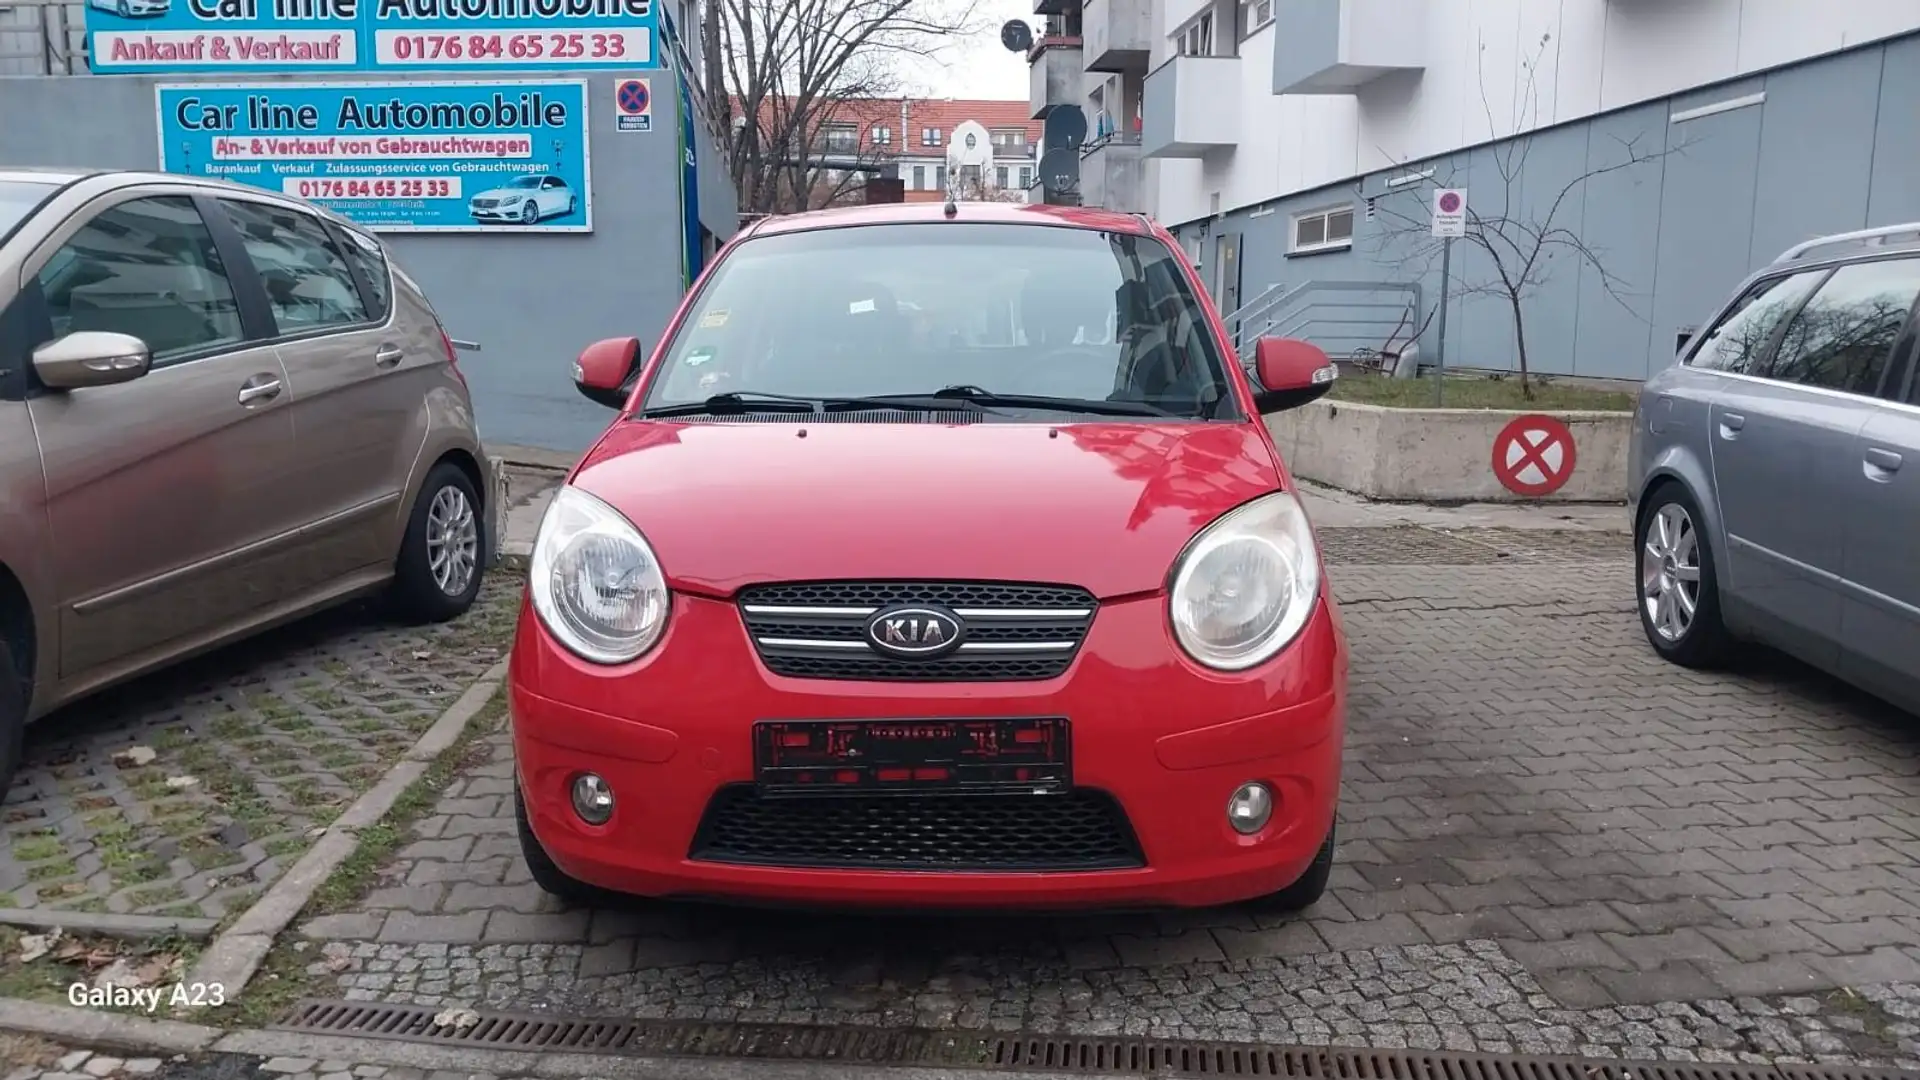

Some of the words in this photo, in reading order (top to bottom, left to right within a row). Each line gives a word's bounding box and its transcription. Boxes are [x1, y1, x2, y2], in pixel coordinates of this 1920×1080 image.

[111, 35, 204, 60] Ankauf
[210, 36, 230, 60] &
[233, 34, 341, 60] Verkauf
[394, 36, 462, 59] 0176
[468, 36, 503, 58] 84
[509, 35, 543, 58] 65
[551, 34, 584, 58] 25
[591, 34, 625, 58] 33
[177, 98, 239, 131] Car
[248, 95, 319, 131] line
[337, 92, 567, 130] Automobile
[216, 138, 246, 155] An-
[250, 139, 263, 155] &
[265, 137, 336, 155] Verkauf
[339, 141, 372, 154] von
[376, 136, 530, 157] Gebrauchtwagen
[205, 163, 261, 174] Barankauf
[272, 163, 315, 173] Verkauf
[326, 162, 427, 175] Zulassungsservice
[429, 164, 450, 172] von
[452, 161, 549, 174] Gebrauchtwagen
[300, 180, 344, 197] 0176
[348, 180, 370, 197] 84
[374, 180, 396, 196] 65
[400, 180, 423, 196] 25
[427, 180, 449, 196] 33
[885, 619, 945, 642] KIA
